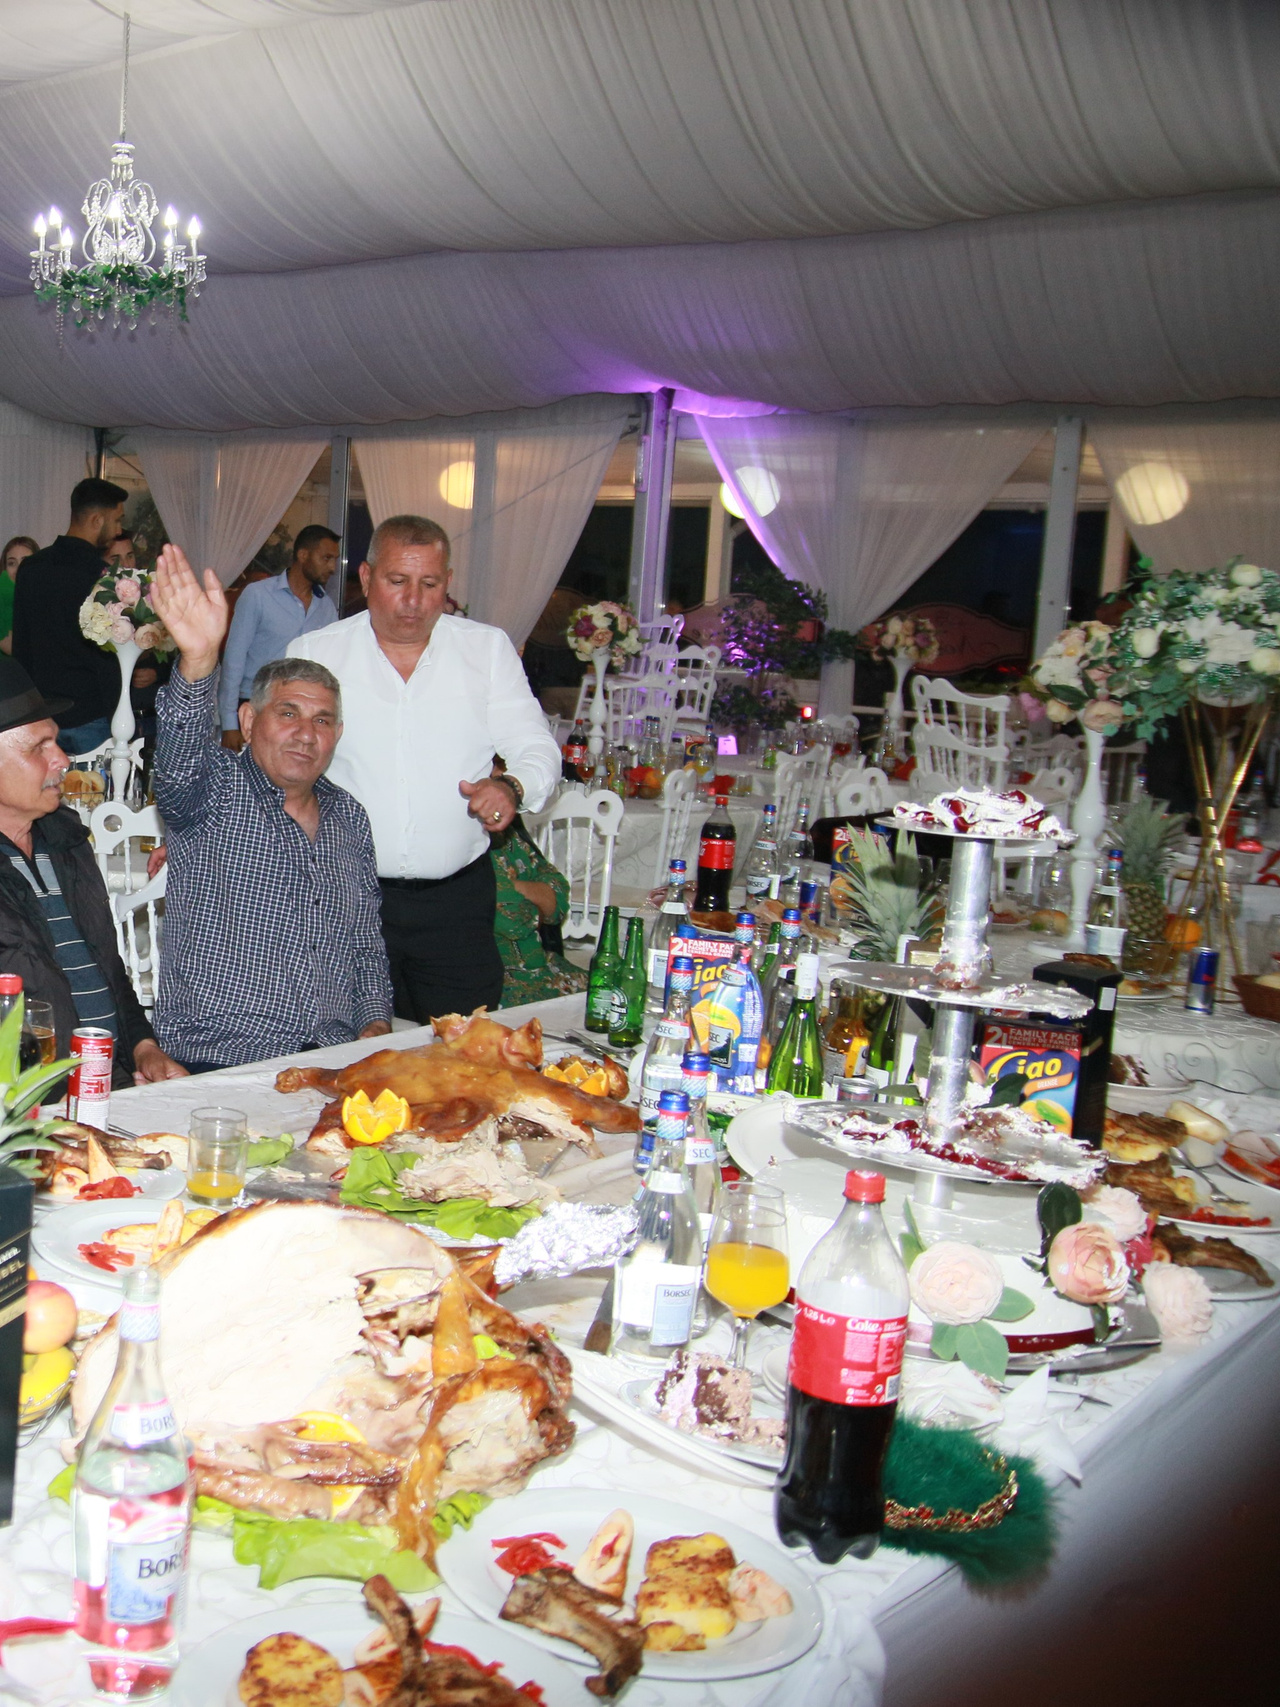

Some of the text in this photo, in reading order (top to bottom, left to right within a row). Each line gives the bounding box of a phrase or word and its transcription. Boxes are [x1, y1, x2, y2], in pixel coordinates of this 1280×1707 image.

[670, 937, 692, 957] 2L
[688, 939, 735, 952] FAMILY PAC
[985, 1026, 1013, 1049] 2L
[1010, 1028, 1079, 1043] FAMILY PACK
[663, 1288, 692, 1298] BORSEC
[846, 1317, 879, 1332] Coke
